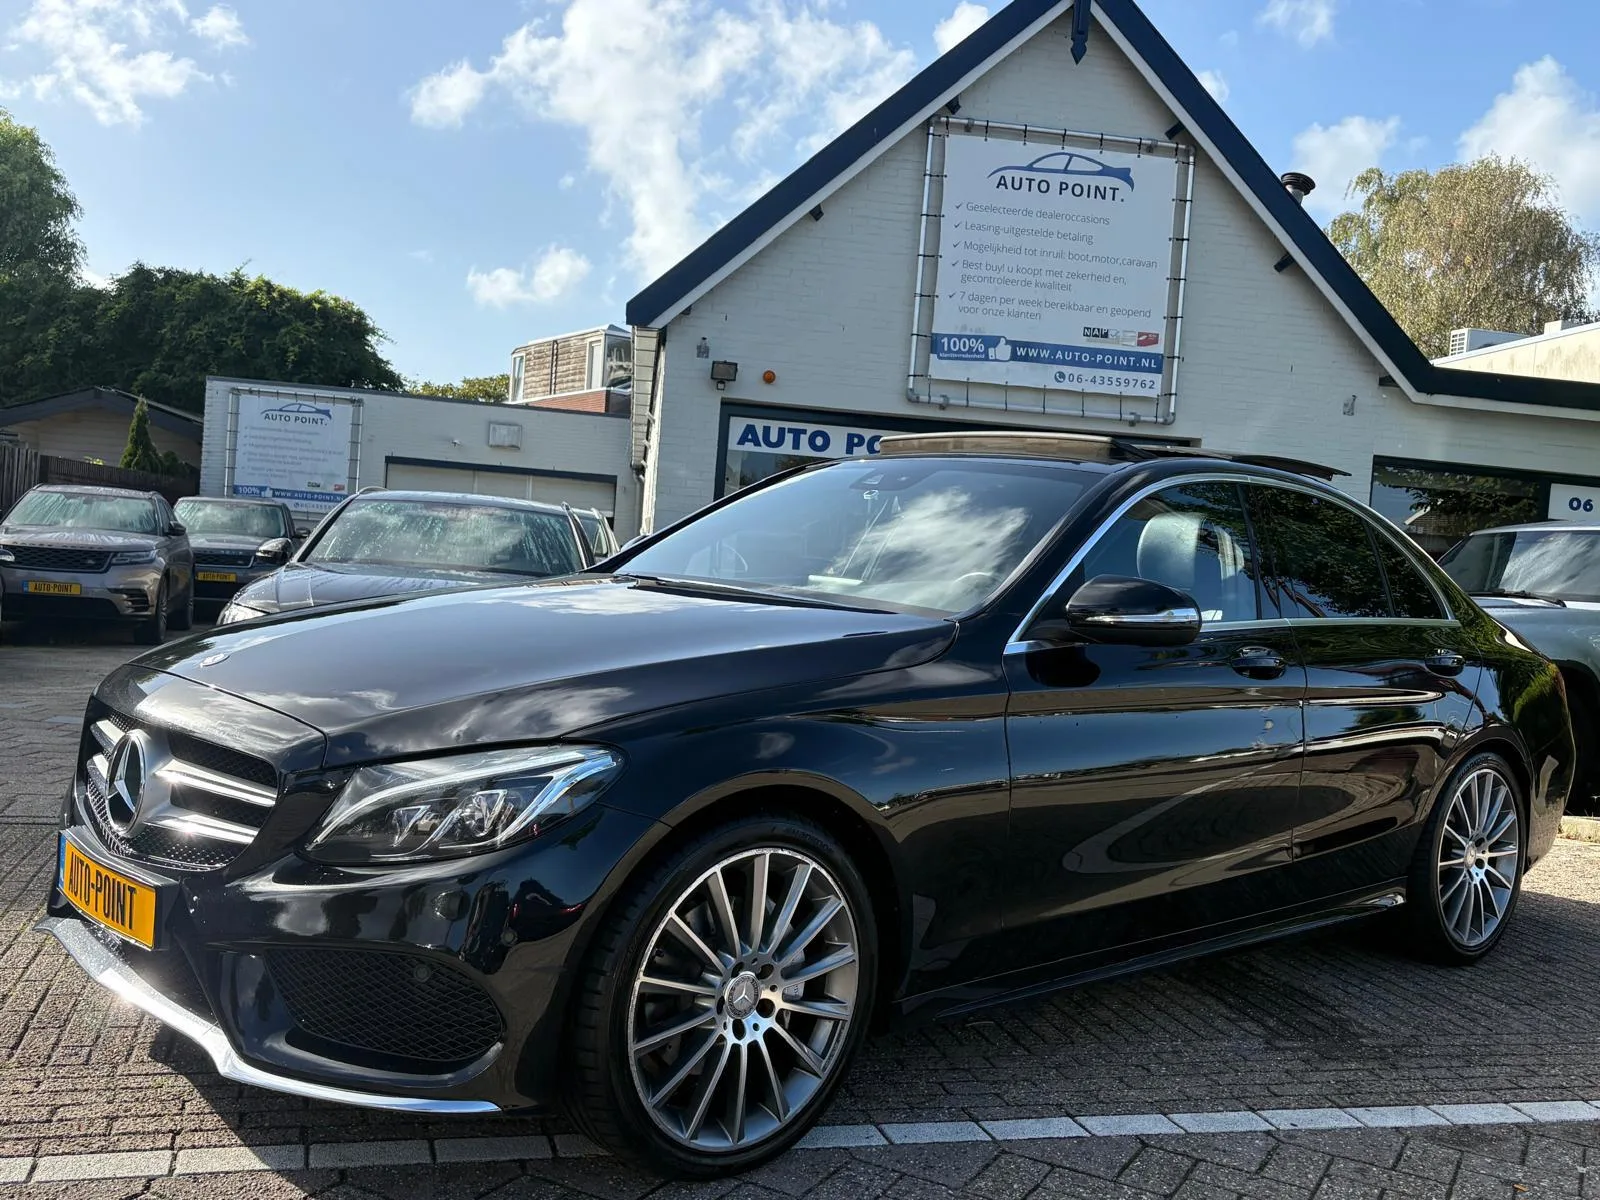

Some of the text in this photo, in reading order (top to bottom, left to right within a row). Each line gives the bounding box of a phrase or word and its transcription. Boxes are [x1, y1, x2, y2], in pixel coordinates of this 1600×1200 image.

[996, 175, 1125, 202] AUTO POINT.
[966, 202, 1110, 225] Geselecteerde dealeroccasions
[965, 222, 1093, 245] Leasing-uitgestelde betaling
[964, 241, 1022, 256] Mogelijkheid
[1024, 247, 1037, 257] tot
[962, 260, 983, 271] Best
[1016, 265, 1043, 277] koopt
[1046, 268, 1064, 278] met
[1066, 269, 1110, 283] zekerheid
[961, 273, 1072, 292] gecontroleerde kwaliteit
[958, 305, 1042, 320] voor onze klanten
[959, 291, 1151, 318] 7 dagen per week bereikbaar en geopend
[1084, 327, 1108, 337] NAP
[941, 337, 984, 352] 100%
[1016, 347, 1157, 368] WWW.AUTO-POINT.NL
[1068, 373, 1156, 389] 06-43559762
[264, 413, 291, 422] AUTO
[737, 424, 831, 452] AUTO
[239, 486, 260, 495] 100%
[1568, 497, 1594, 512] 06
[203, 573, 231, 581] AUTO-POINT
[34, 583, 73, 593] AUTO-POINT
[68, 852, 137, 930] AUTO-POINT
